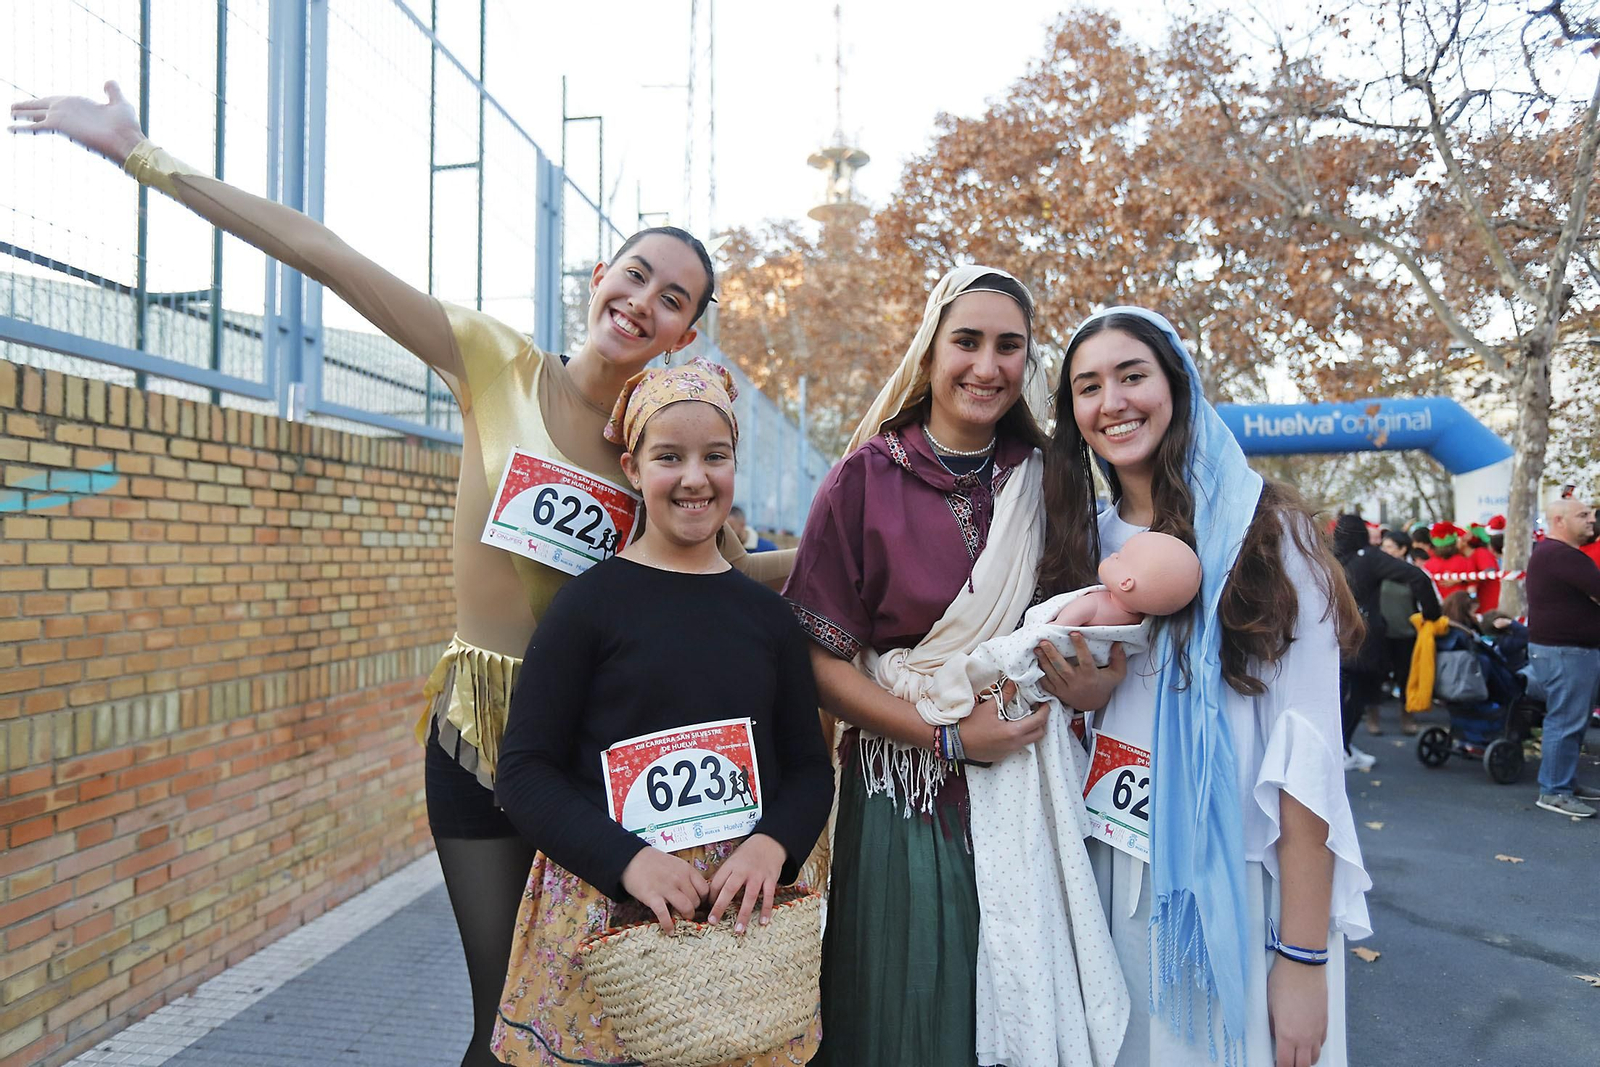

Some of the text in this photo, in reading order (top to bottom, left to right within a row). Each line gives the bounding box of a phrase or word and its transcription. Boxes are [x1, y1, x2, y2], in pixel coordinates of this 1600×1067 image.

[1243, 406, 1432, 438] Huelva original
[551, 465, 578, 480] CARRERA
[577, 473, 590, 484] SAN
[590, 478, 618, 496] SILVESTRE
[561, 477, 593, 494] DE HUELVA
[533, 487, 604, 546] 622
[645, 736, 676, 748] CARRERA
[676, 733, 690, 742] SAN
[691, 728, 723, 740] SILVESTRE
[661, 741, 698, 753] DE HUELVA
[1137, 757, 1146, 766] DE
[646, 755, 726, 812] 623
[724, 821, 743, 831] Huelva
